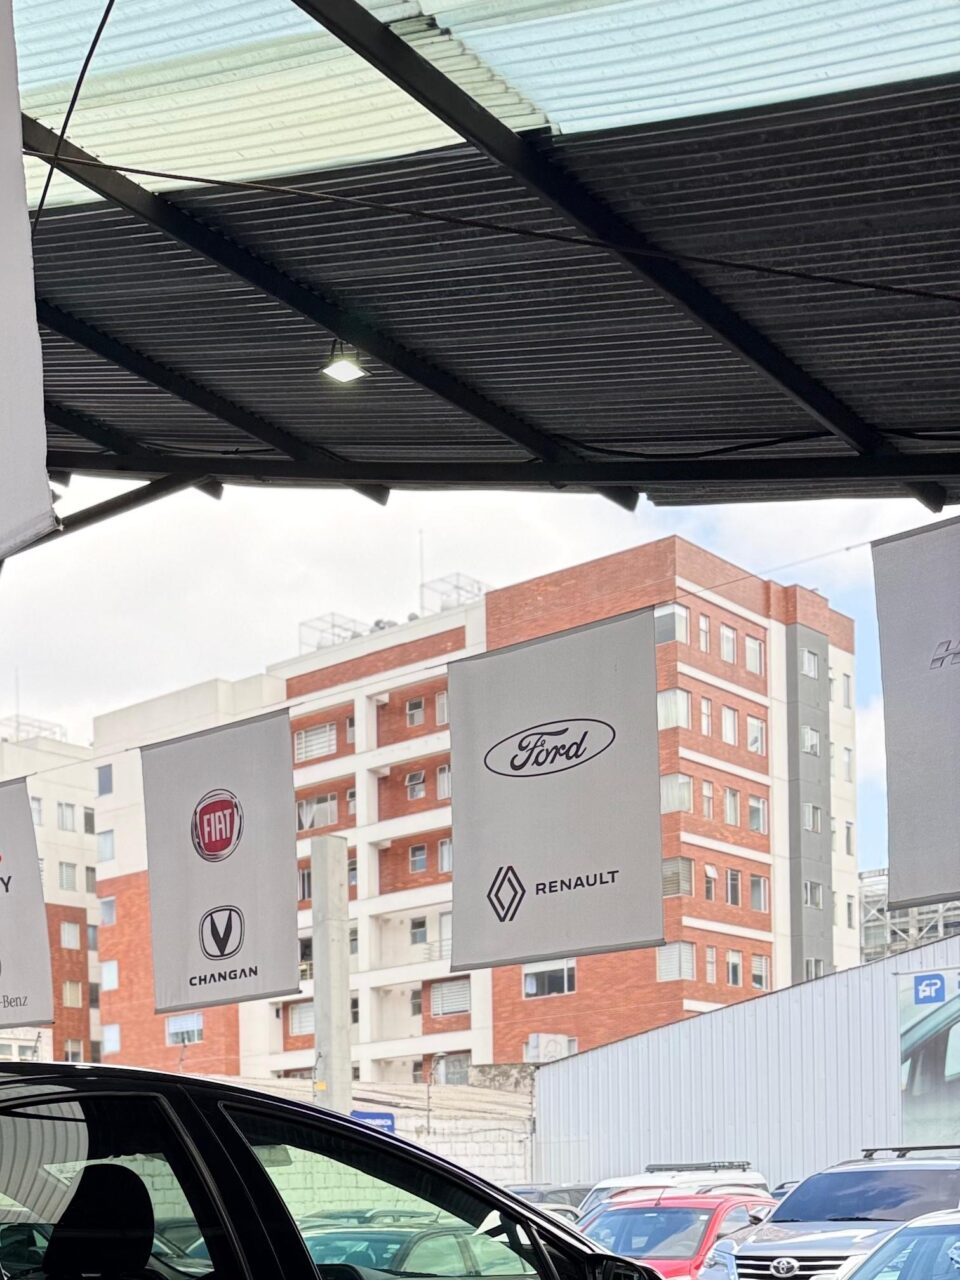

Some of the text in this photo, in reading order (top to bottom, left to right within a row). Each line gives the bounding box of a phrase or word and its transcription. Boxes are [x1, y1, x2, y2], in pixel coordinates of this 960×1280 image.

[510, 727, 589, 772] Ford
[203, 808, 233, 841] FIAT
[536, 869, 620, 896] RENAULT
[189, 966, 258, 987] CHANGAN
